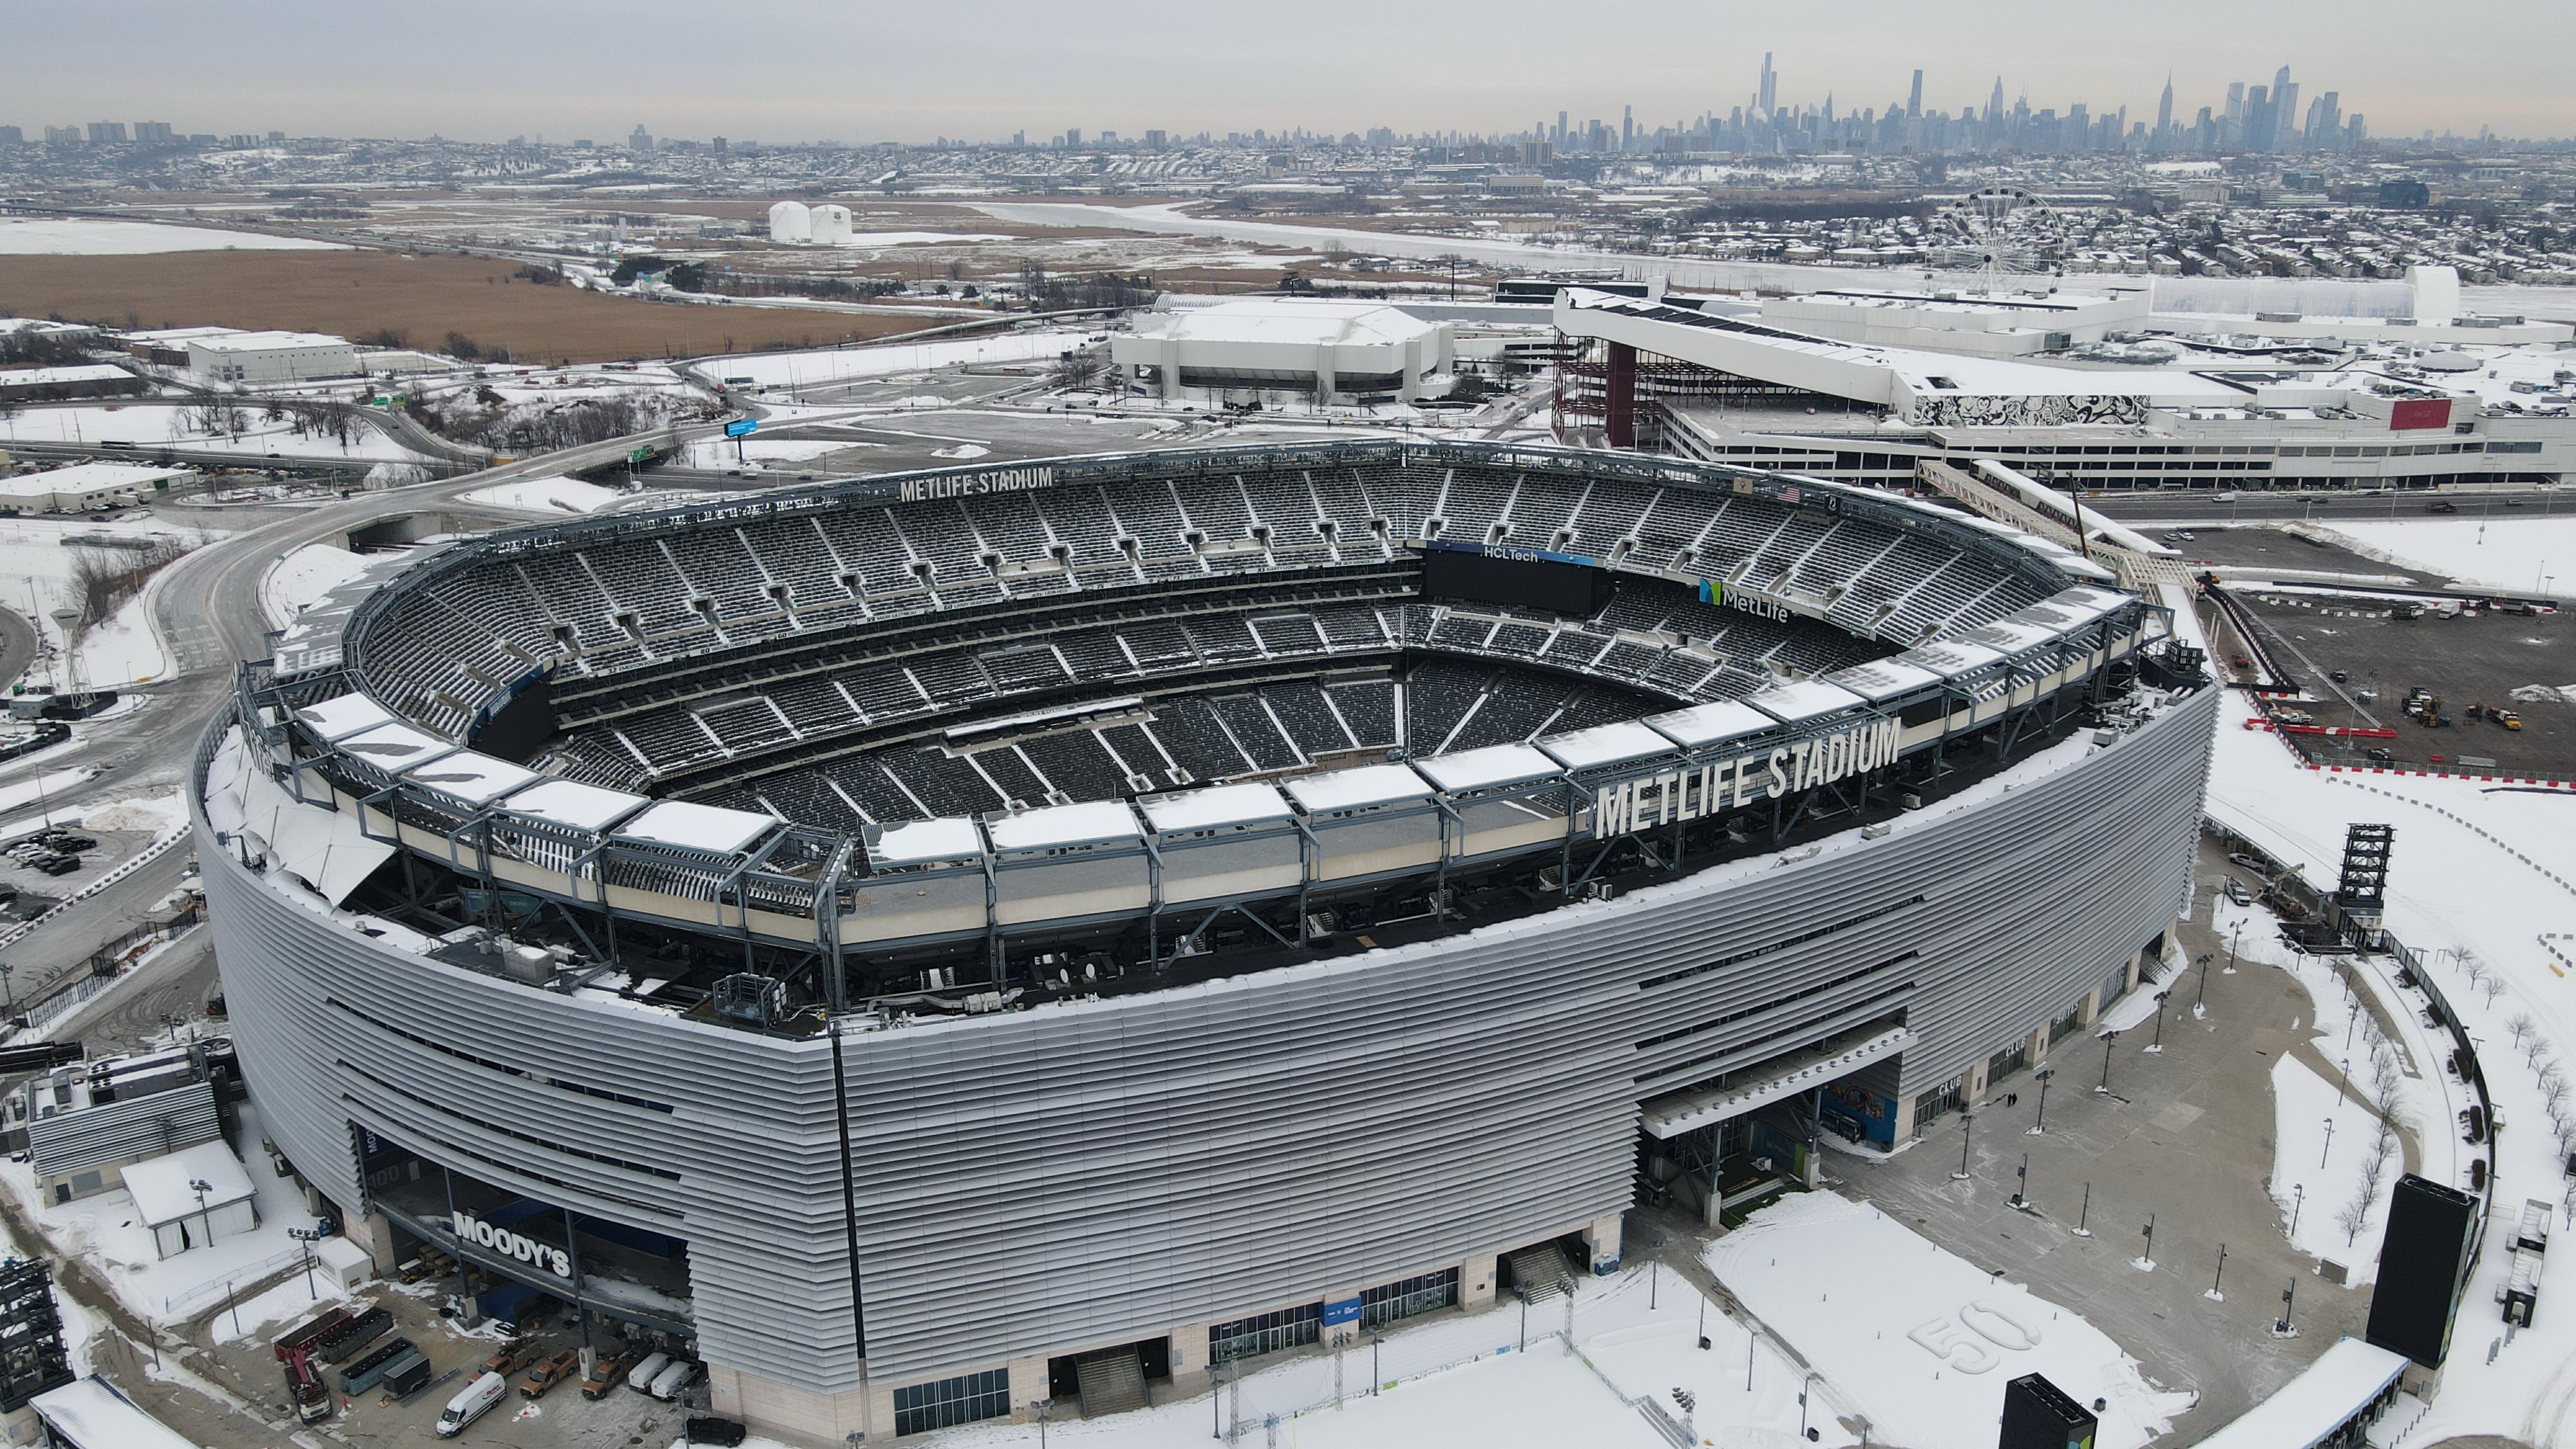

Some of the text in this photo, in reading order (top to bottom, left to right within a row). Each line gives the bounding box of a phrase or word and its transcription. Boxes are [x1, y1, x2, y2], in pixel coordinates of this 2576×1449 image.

[900, 466, 1053, 502] METLIFE STADIUM
[1484, 546, 1538, 563] HCLTech
[1723, 589, 1788, 623] MetLife
[1595, 716, 1902, 840] METLIFE STADIUM
[2005, 1037, 2027, 1057] CLUB
[1938, 1074, 1963, 1096] CLUB
[453, 1211, 571, 1278] MOODY'S
[1907, 1300, 2042, 1374] 50
